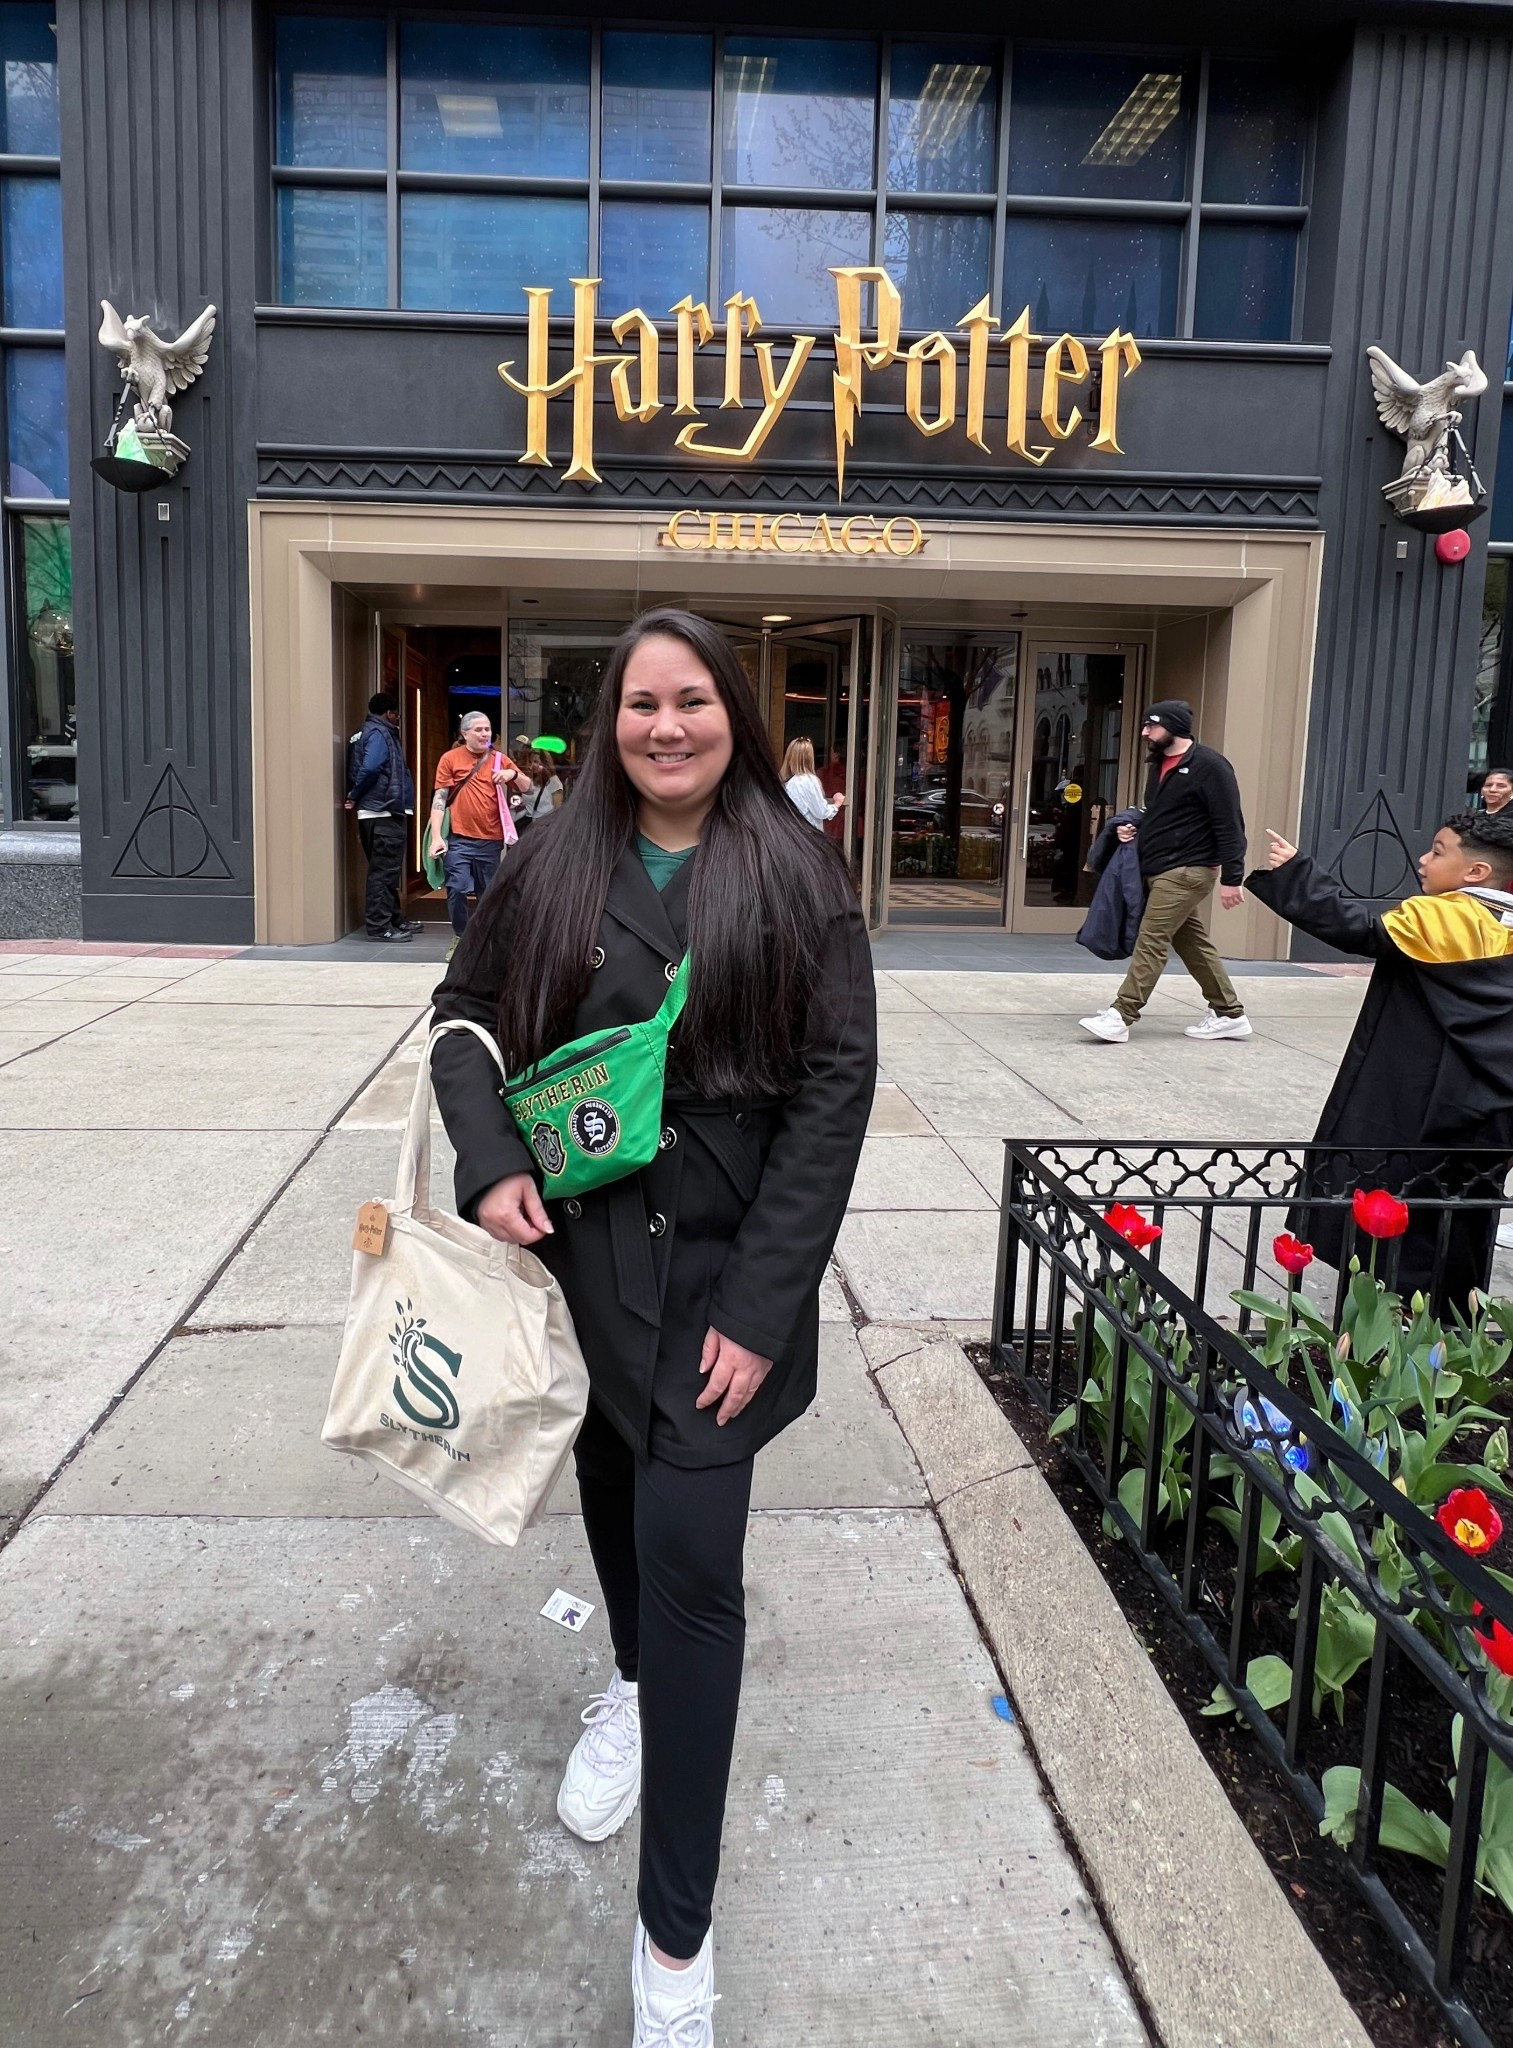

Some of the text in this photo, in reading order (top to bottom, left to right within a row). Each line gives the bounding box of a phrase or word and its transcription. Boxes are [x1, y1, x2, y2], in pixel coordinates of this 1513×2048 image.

[498, 266, 1142, 505] Harry Potter
[669, 510, 923, 556] CHICAGO
[514, 1062, 610, 1121] SLYTHERIN
[393, 1330, 462, 1429] S
[379, 1412, 471, 1462] SLYTHERIN
